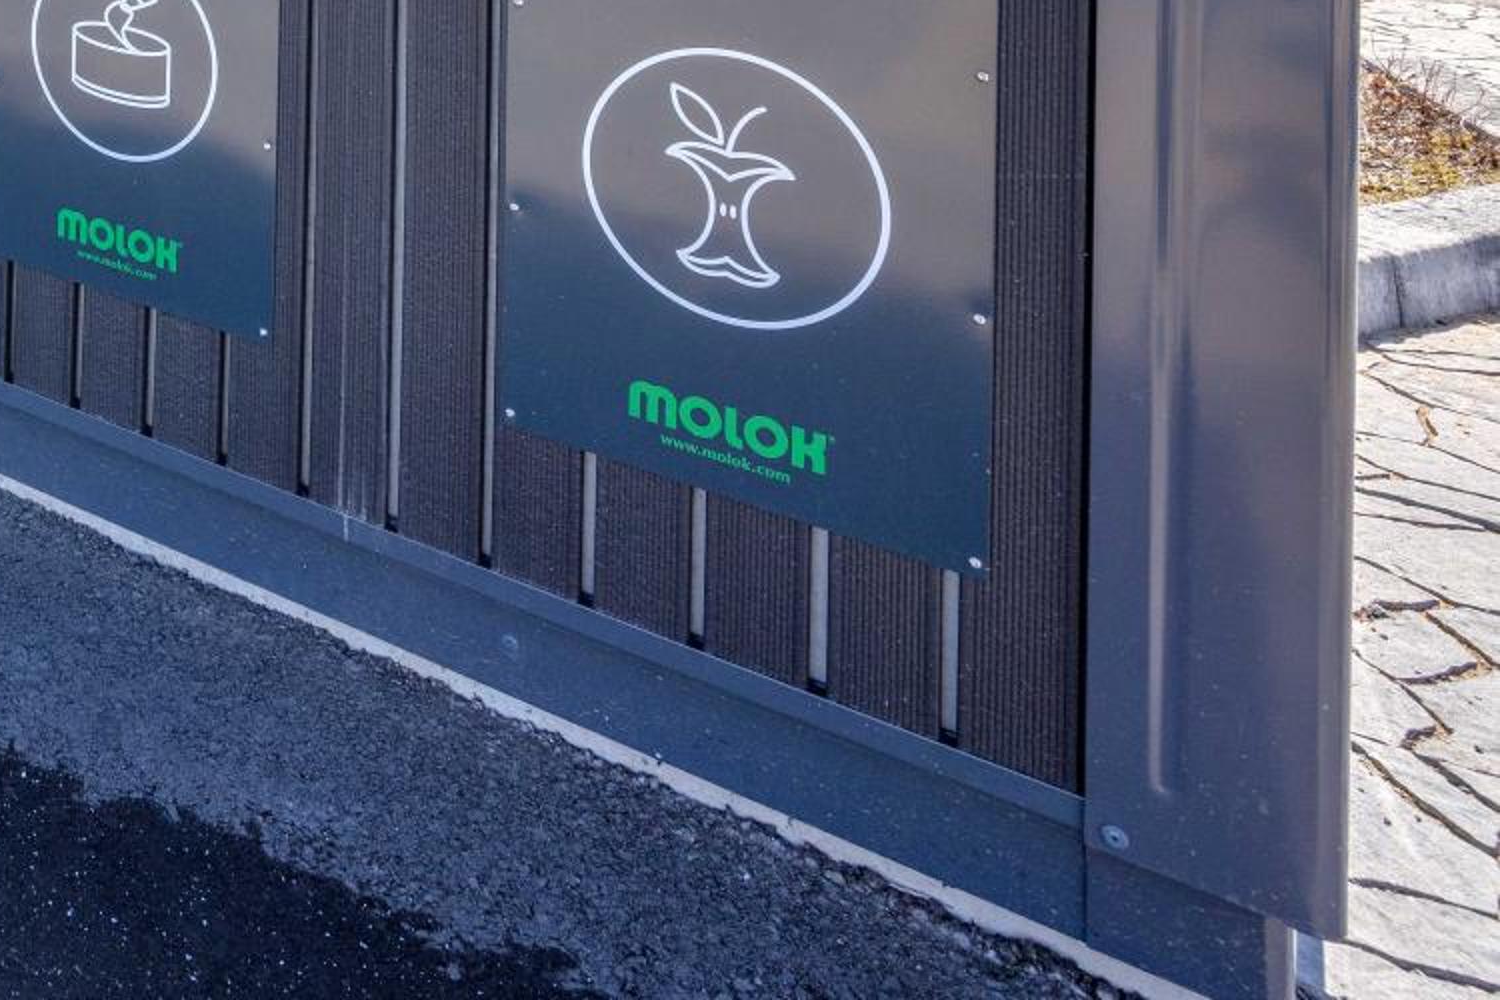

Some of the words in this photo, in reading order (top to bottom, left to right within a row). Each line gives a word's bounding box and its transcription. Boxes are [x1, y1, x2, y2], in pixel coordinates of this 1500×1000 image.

[57, 207, 178, 273] MOLOK
[628, 379, 827, 475] MOLOK
[660, 433, 791, 485] www.molok.com
